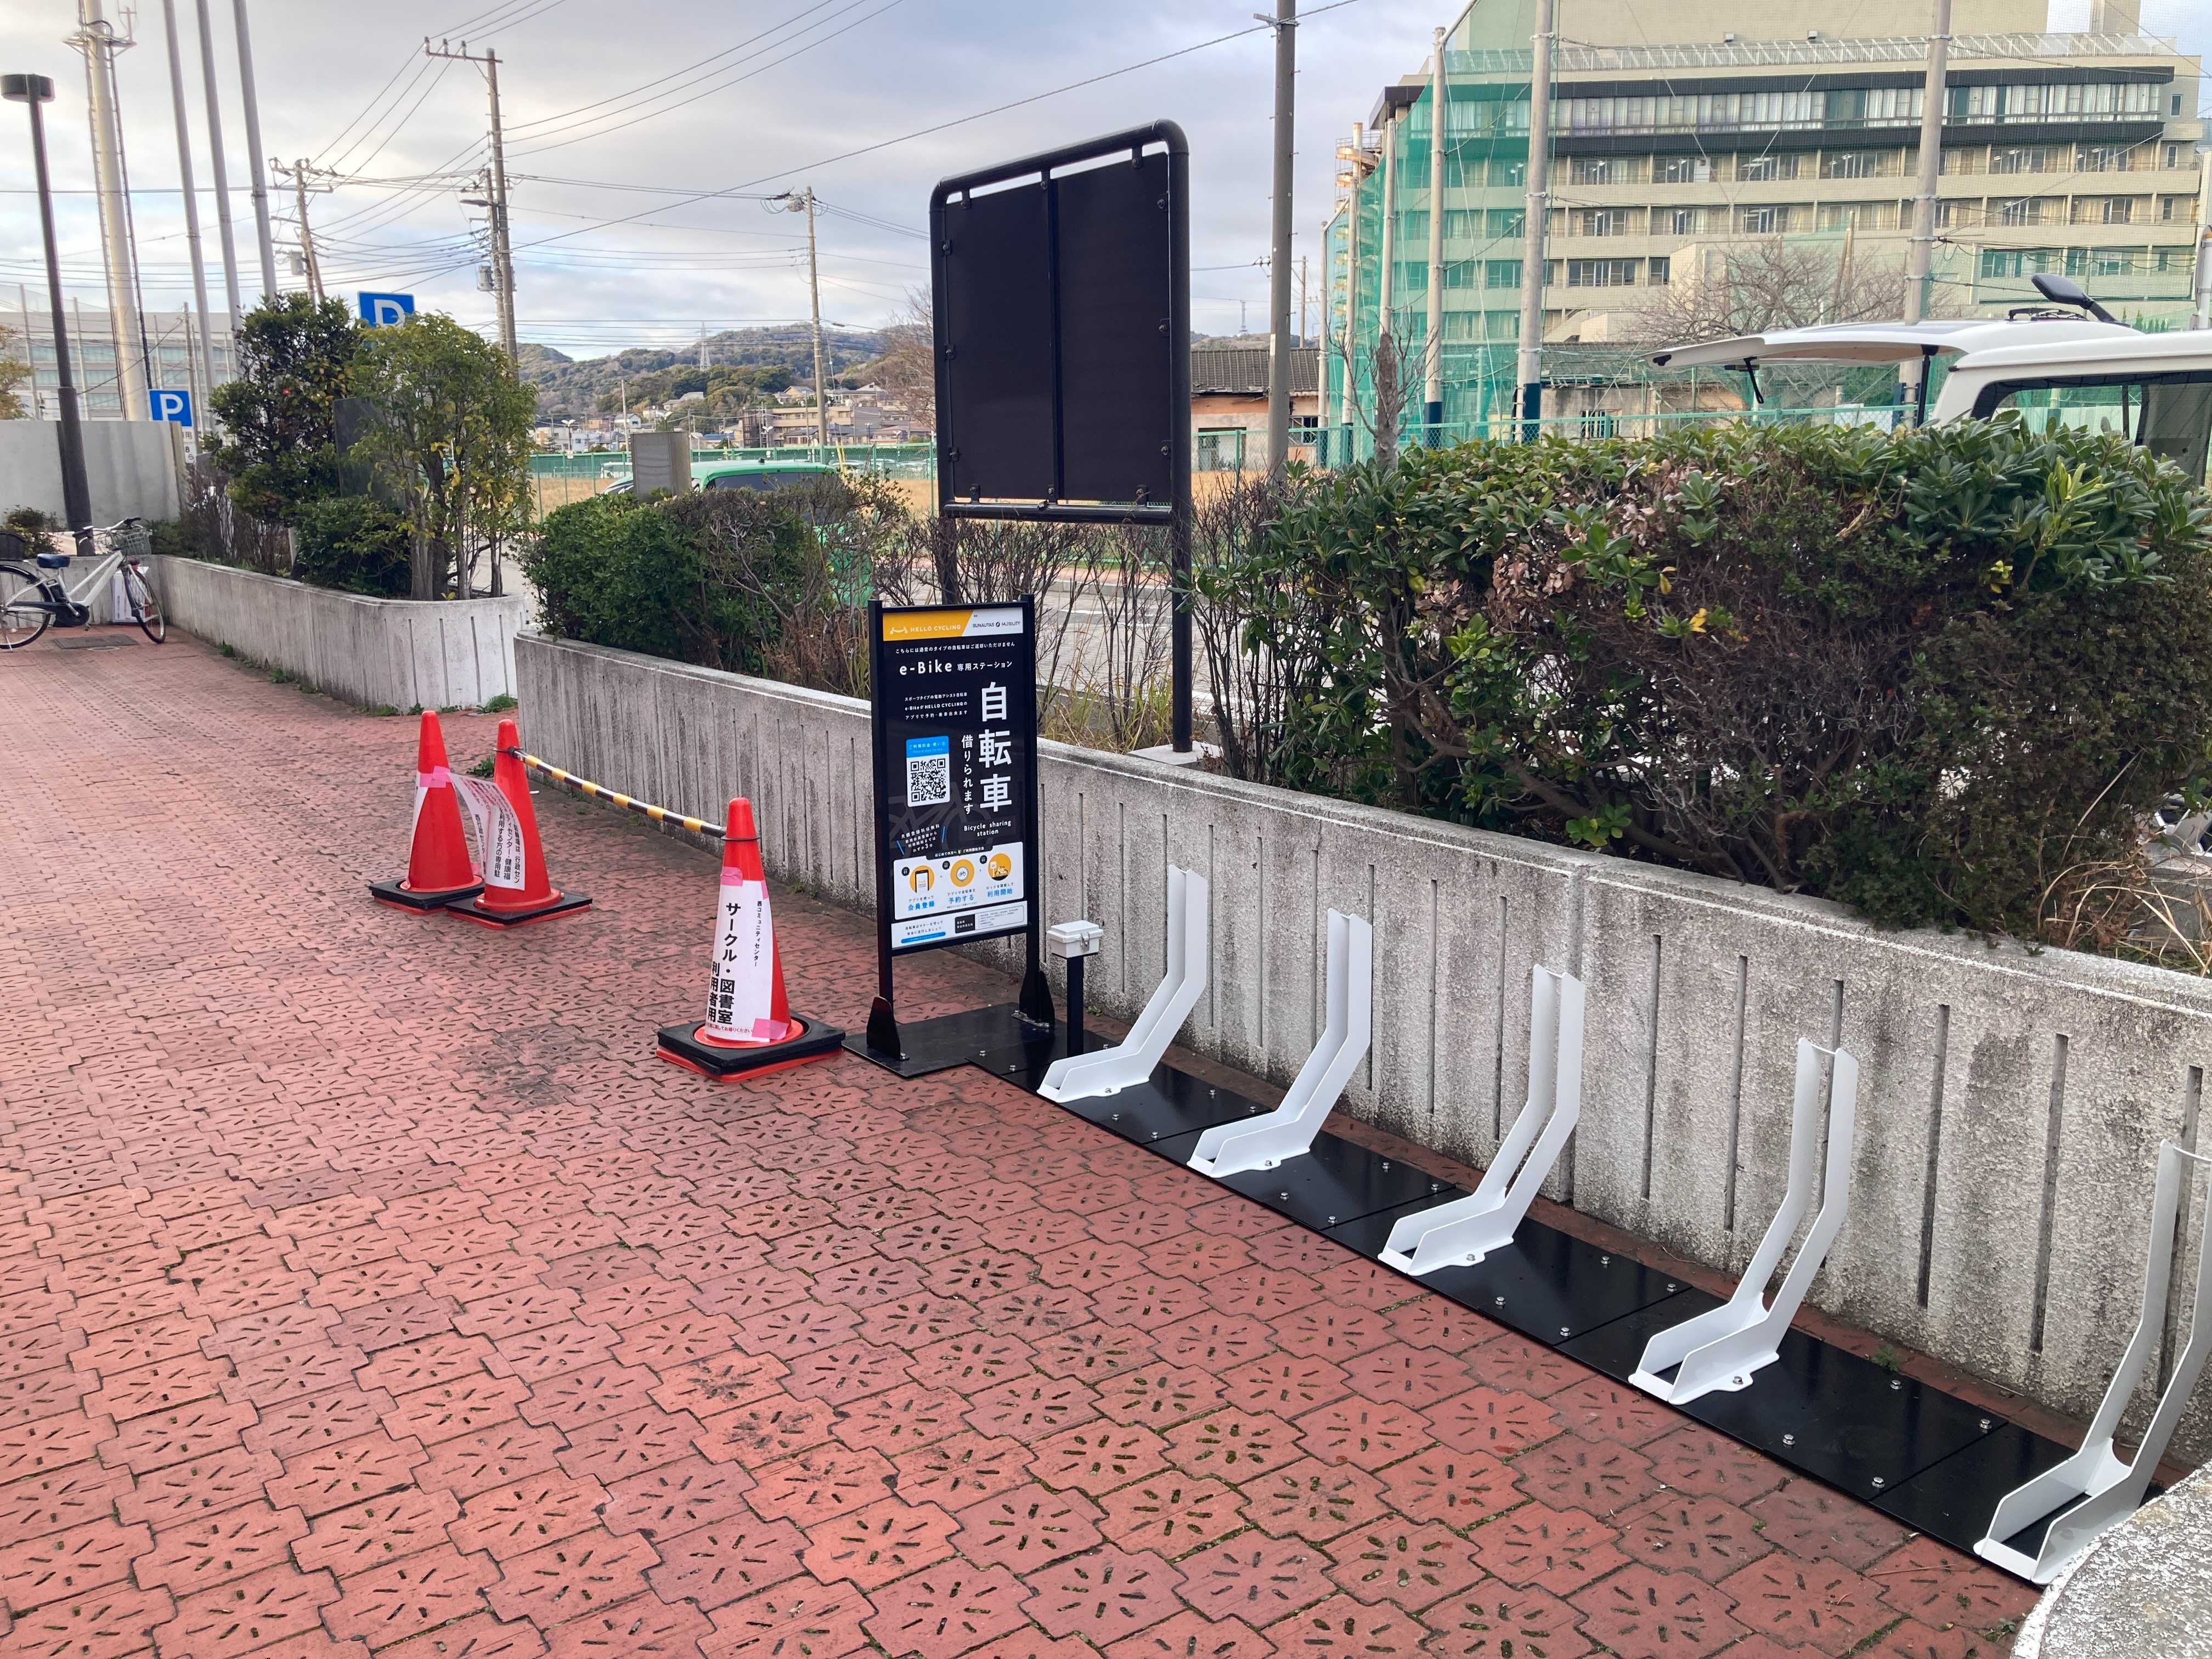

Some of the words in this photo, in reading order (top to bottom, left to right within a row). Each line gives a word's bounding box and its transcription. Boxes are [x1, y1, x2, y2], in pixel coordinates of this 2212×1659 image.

[160, 393, 183, 421] P
[899, 659, 952, 675] e-Bike
[957, 661, 1012, 672] 専用ステーション
[979, 681, 1012, 812] 自転車
[961, 734, 973, 814] 借りられます
[964, 823, 986, 832] Bicycle
[989, 820, 1012, 830] sharing
[977, 829, 999, 837] station
[949, 894, 974, 904] 予約する
[988, 888, 1013, 898] 利用開始
[908, 900, 935, 911] 会員登録
[754, 900, 762, 967] 西コミュニティセンター
[717, 902, 741, 1025] サークル・図書室
[707, 961, 720, 1022] 利用者用
